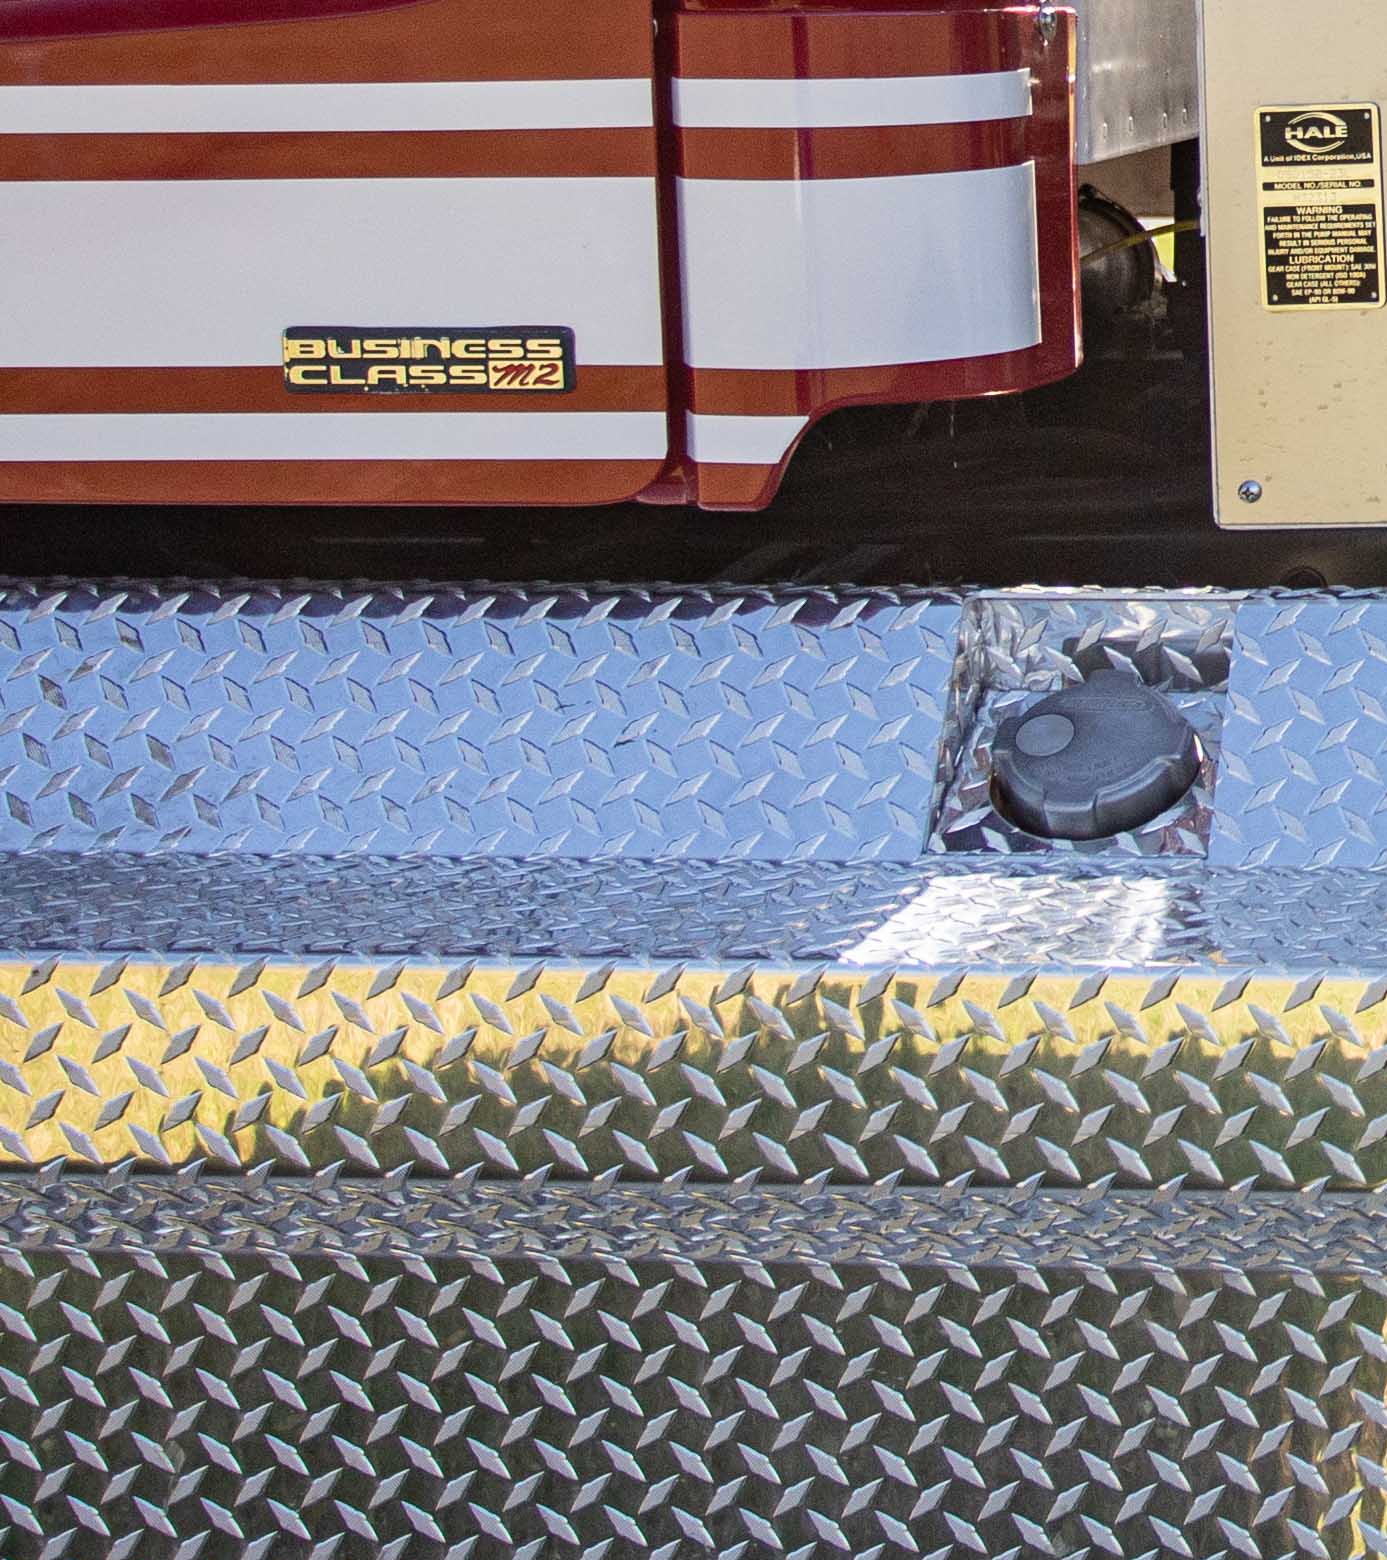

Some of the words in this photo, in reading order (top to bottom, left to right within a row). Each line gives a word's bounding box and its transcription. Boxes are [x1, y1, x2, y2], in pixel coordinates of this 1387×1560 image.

[1285, 126, 1348, 139] HALE
[1274, 182, 1301, 190] MODEL
[1296, 205, 1343, 215] WARNING
[1289, 254, 1354, 264] LUBRICATION
[288, 338, 563, 360] BUSINESS
[289, 365, 488, 385] CLASS
[492, 363, 560, 386] M2
